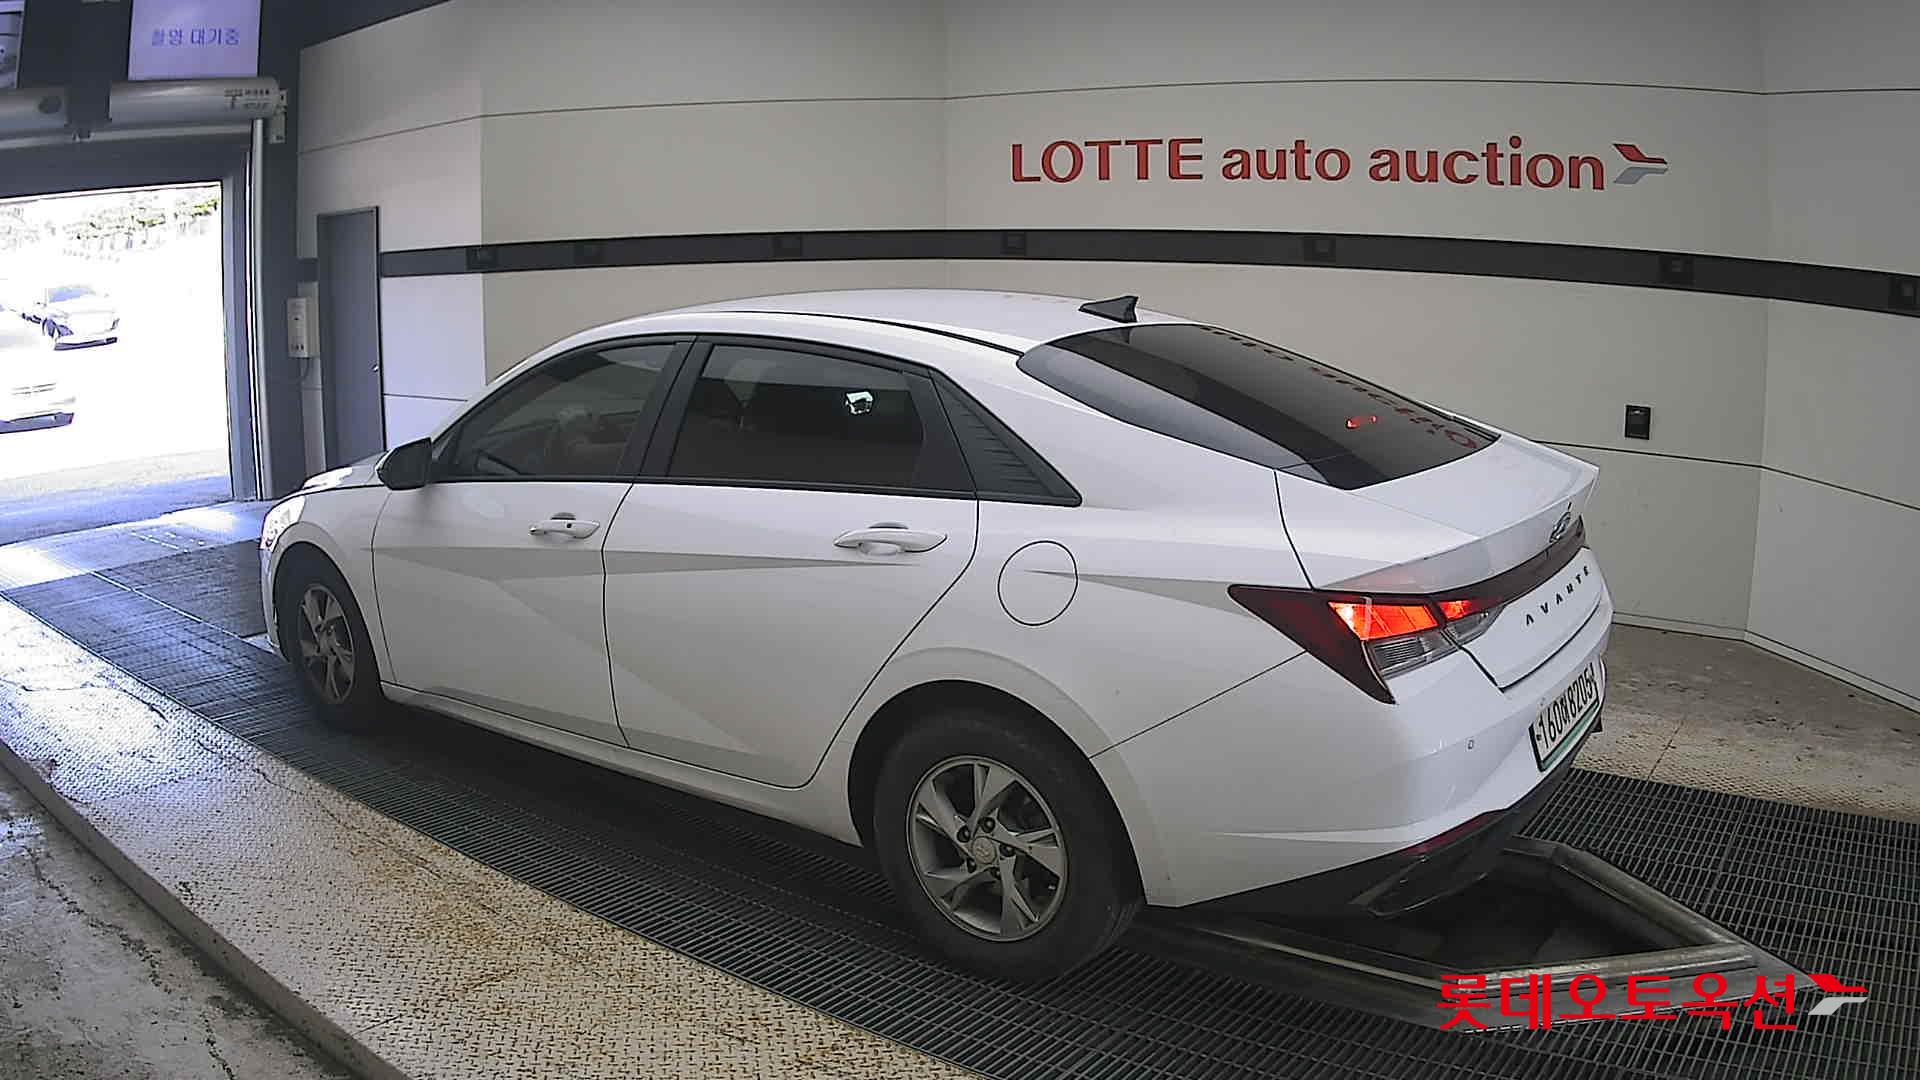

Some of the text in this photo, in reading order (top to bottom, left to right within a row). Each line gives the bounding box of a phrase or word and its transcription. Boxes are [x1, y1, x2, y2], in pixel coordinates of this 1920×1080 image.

[1011, 135, 1605, 191] LOTTE auto auction
[1525, 565, 1589, 626] AVANTE
